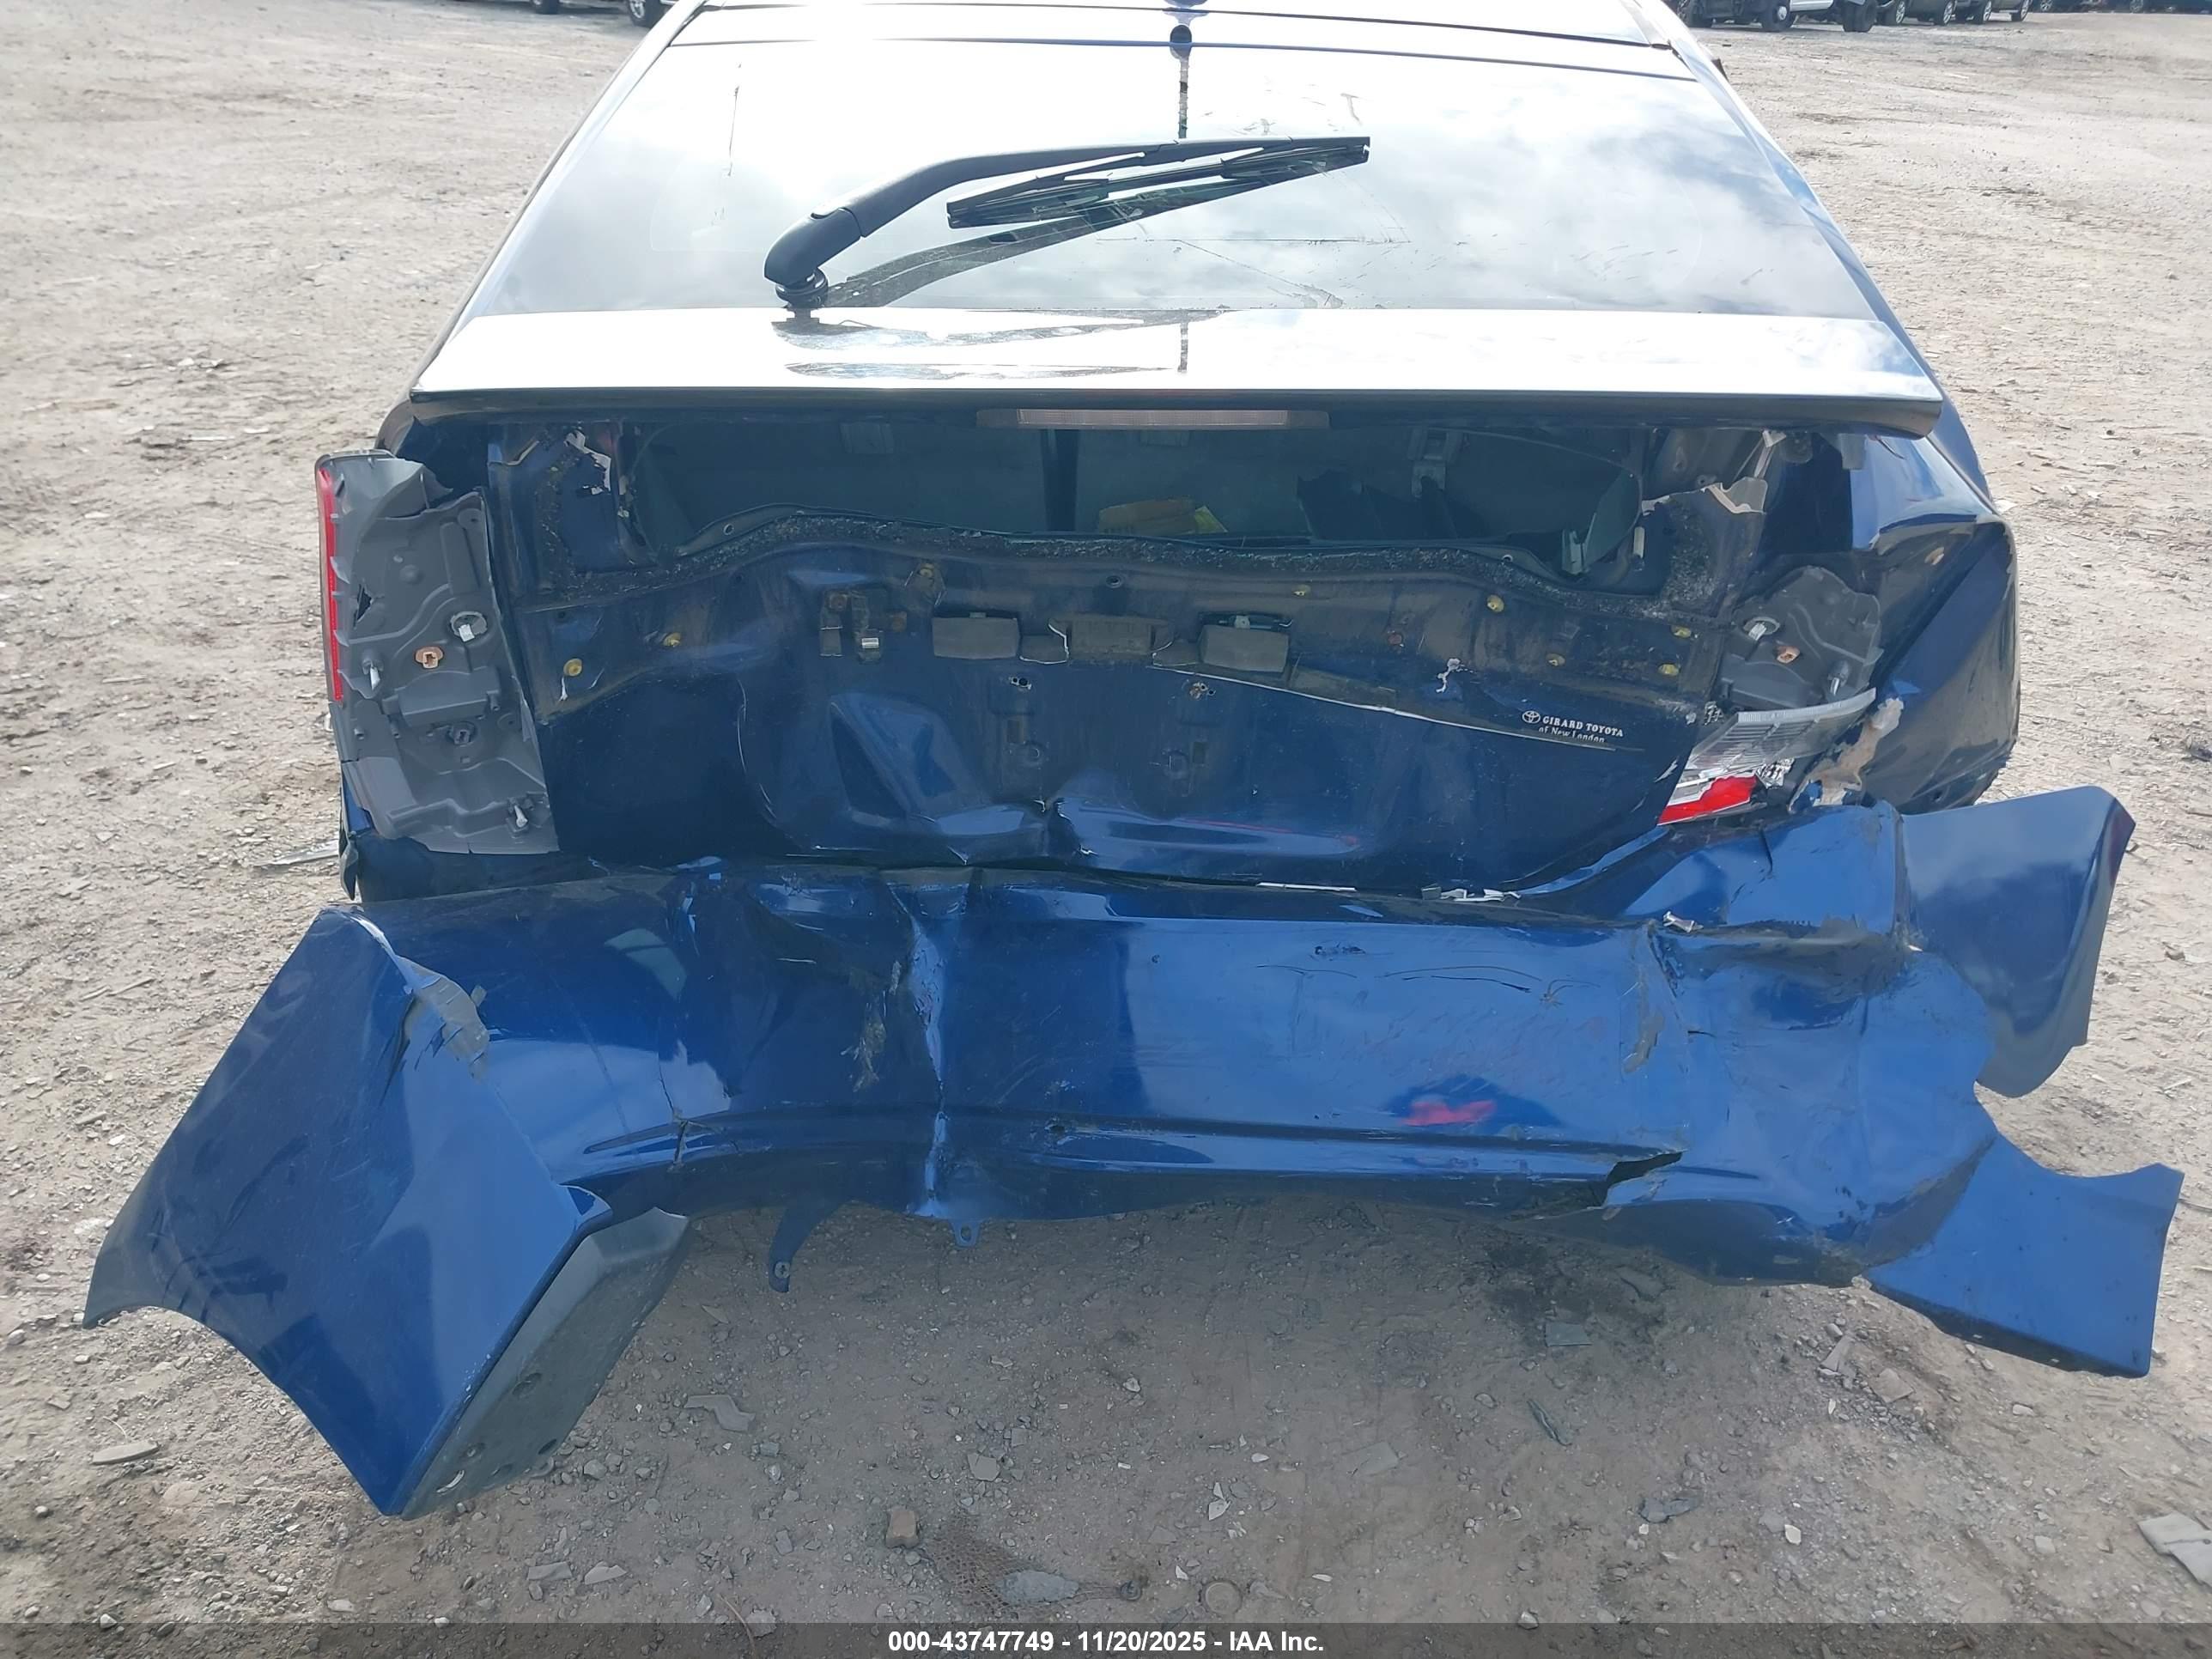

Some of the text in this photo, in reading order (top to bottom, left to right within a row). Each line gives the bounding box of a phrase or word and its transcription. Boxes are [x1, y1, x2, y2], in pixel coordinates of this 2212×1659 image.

[1542, 716, 1623, 737] GIRARD TOYOTA
[1551, 727, 1571, 737] New
